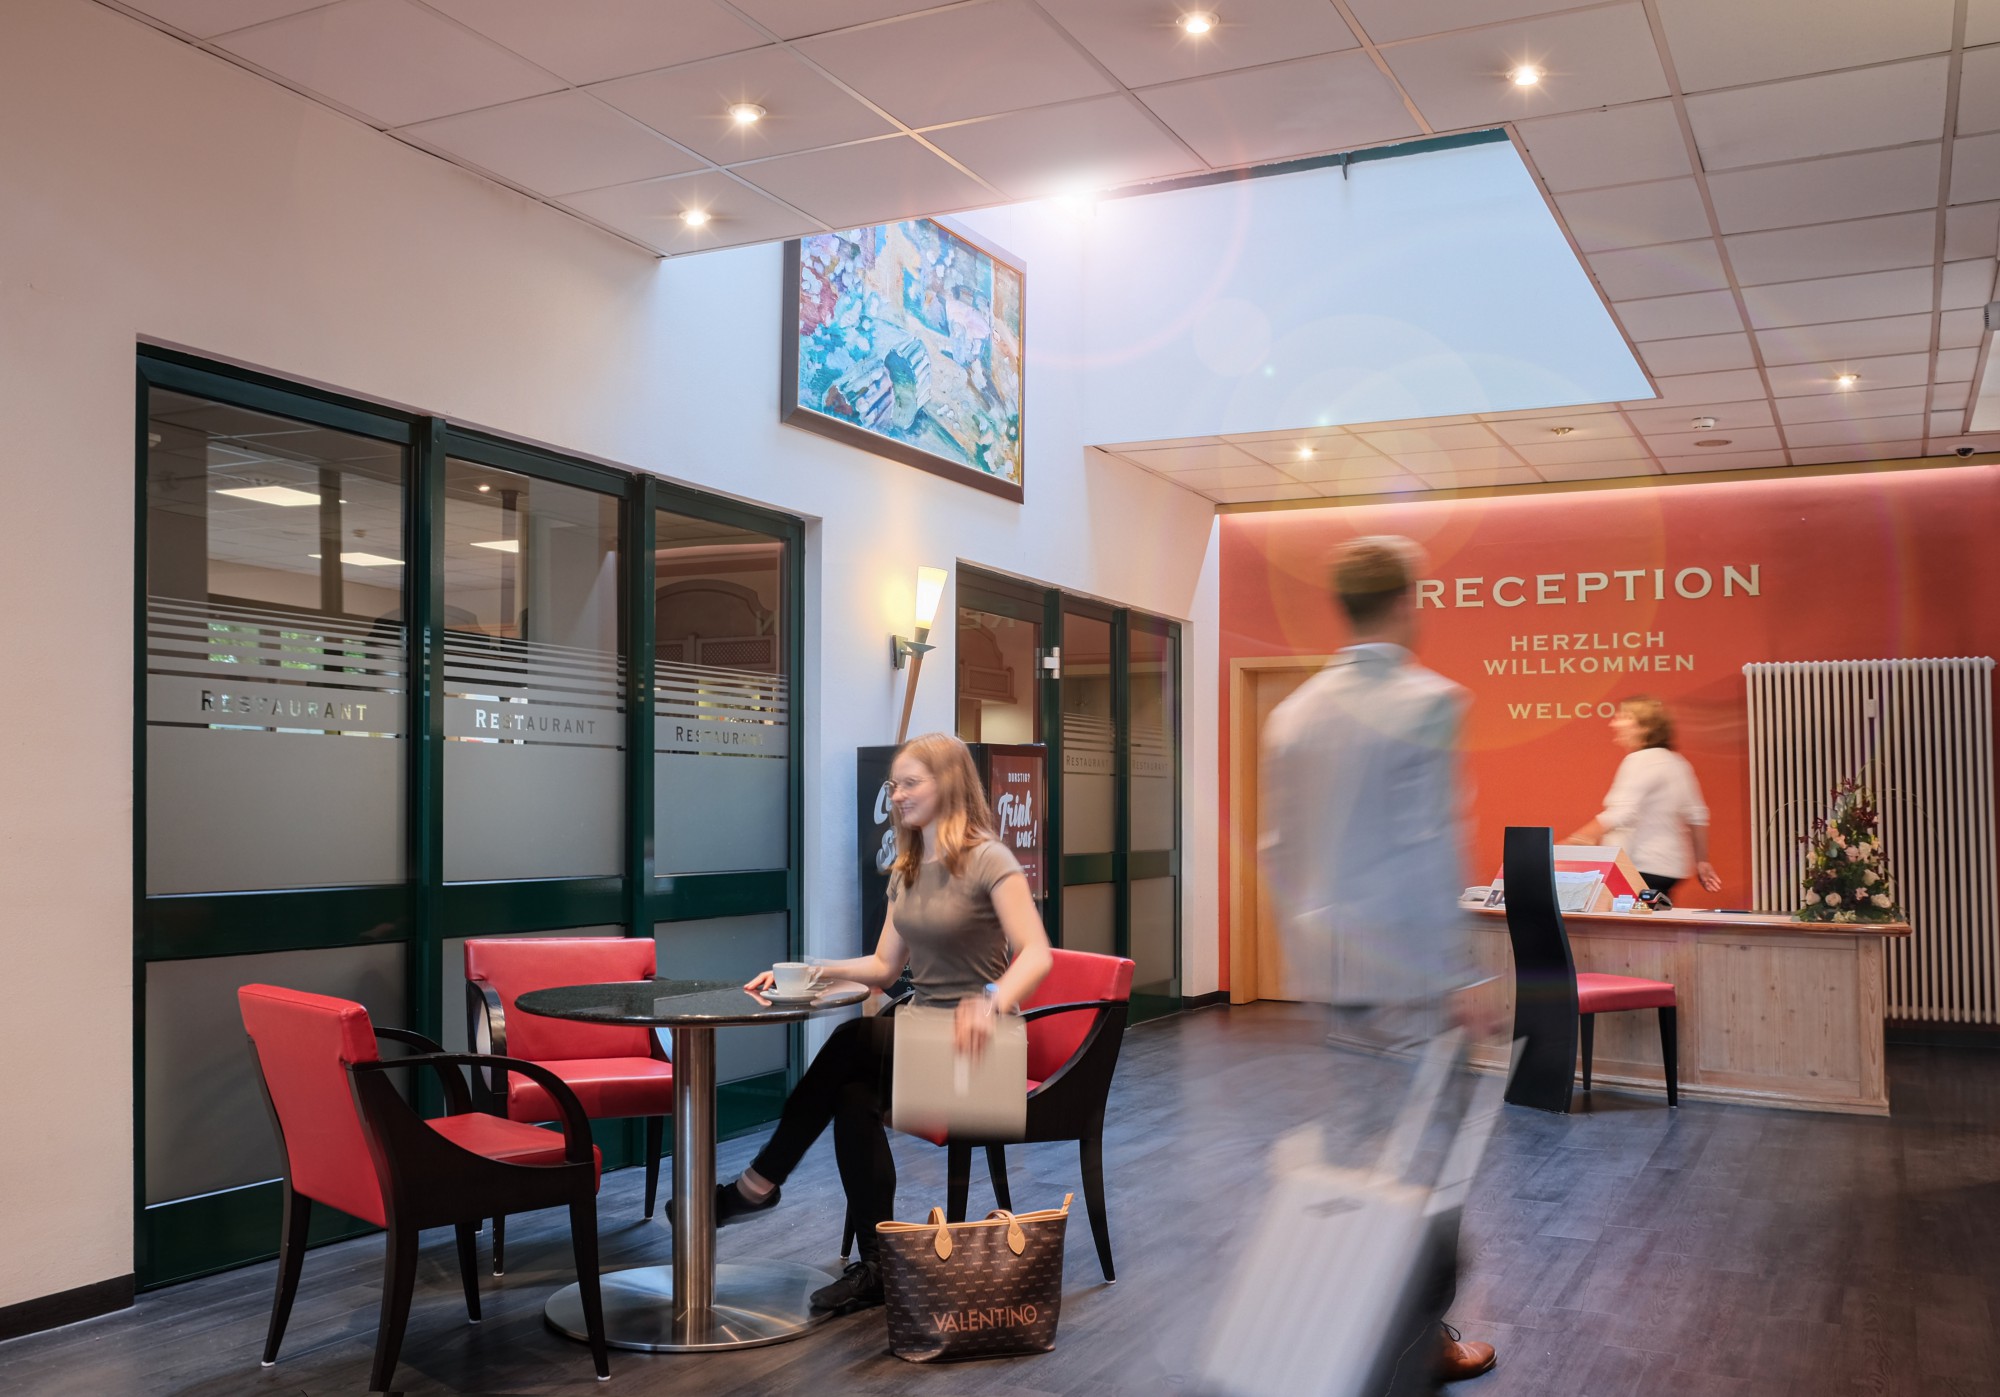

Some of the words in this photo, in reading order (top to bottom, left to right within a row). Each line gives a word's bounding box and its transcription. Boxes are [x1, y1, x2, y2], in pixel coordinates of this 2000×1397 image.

[1415, 564, 1761, 609] RECEPTION
[1511, 631, 1665, 652] HERZLICH
[1483, 654, 1695, 676] WILLKOMMEN
[201, 689, 367, 721] RESTAURANT
[1507, 701, 1617, 720] WELCO
[475, 708, 596, 734] RESTAURANT
[998, 789, 1033, 841] Trink
[933, 1304, 1037, 1332] VALENTINO
